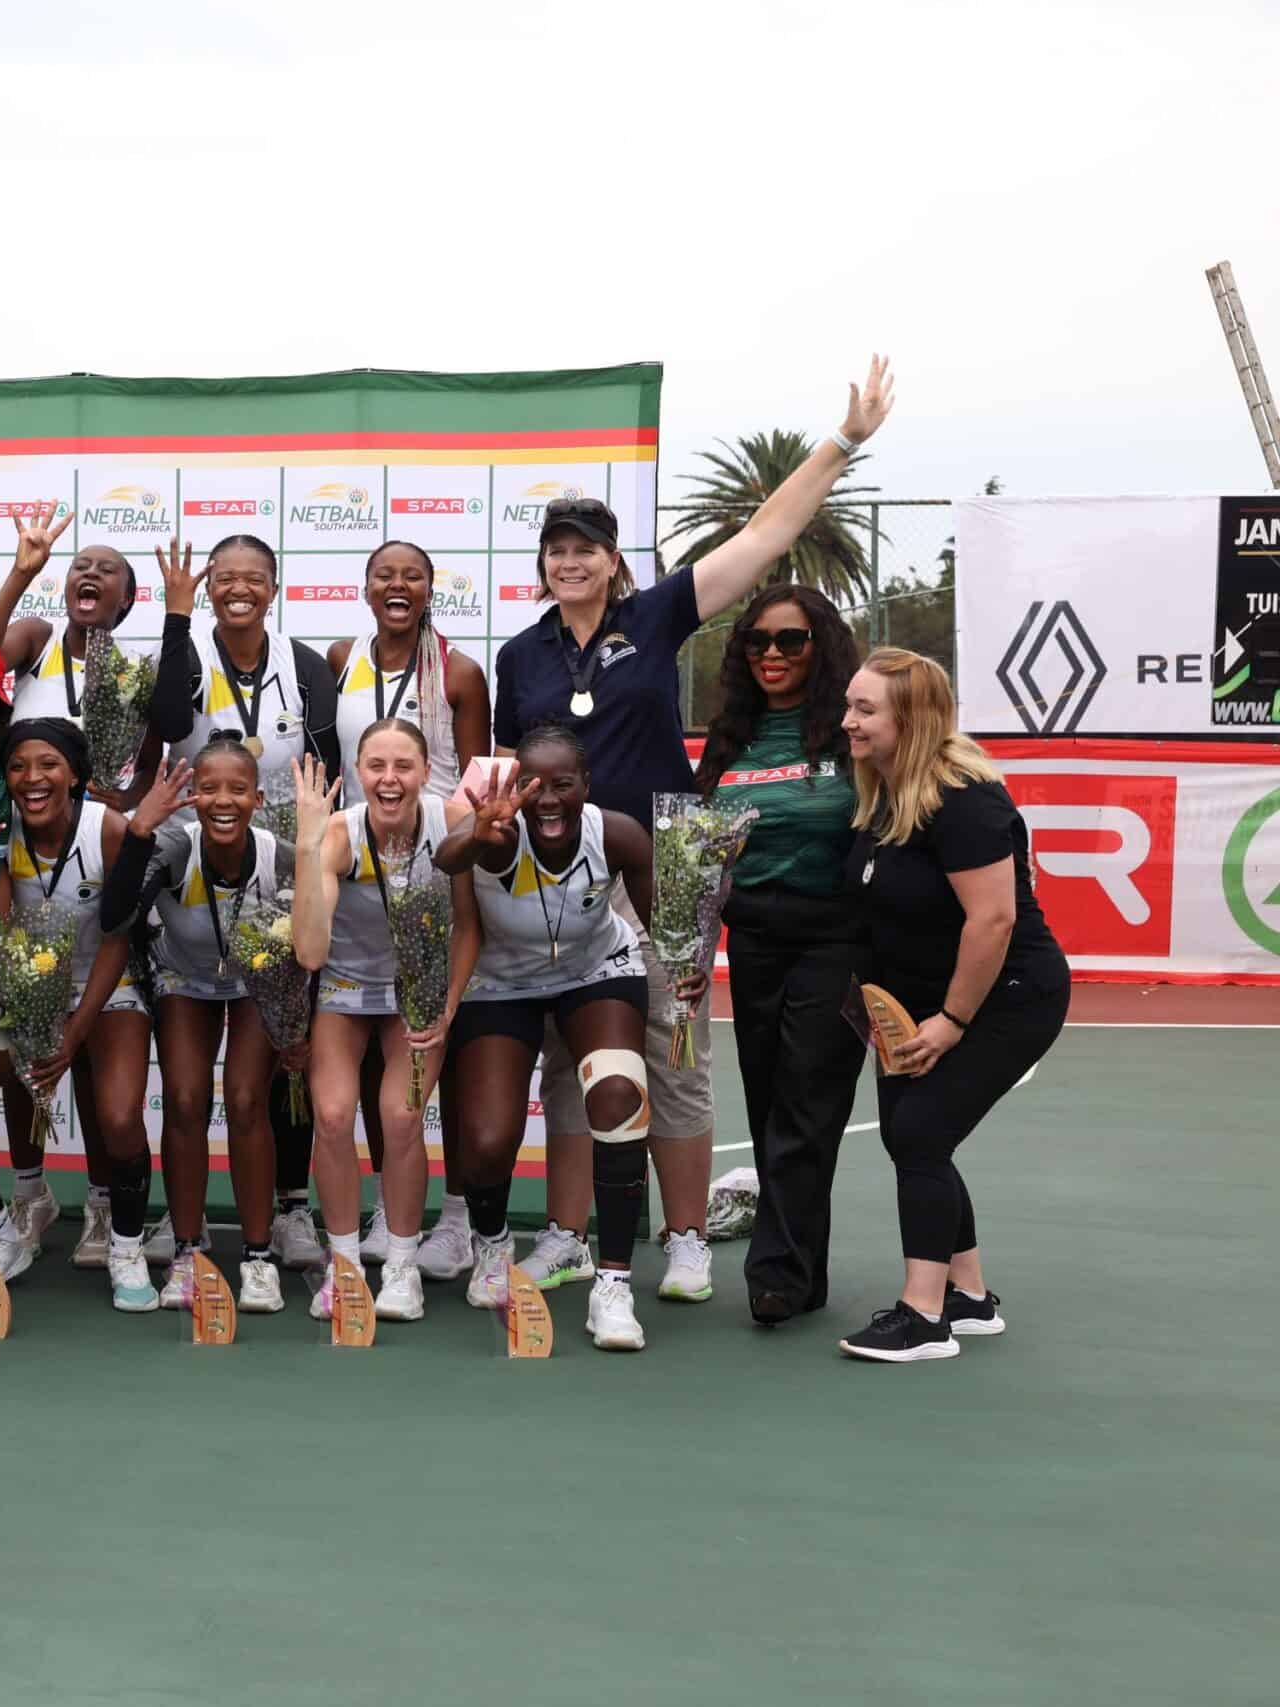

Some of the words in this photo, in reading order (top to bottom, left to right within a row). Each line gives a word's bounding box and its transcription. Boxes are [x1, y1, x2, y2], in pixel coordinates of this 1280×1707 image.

[200, 502, 255, 513] SPAR
[407, 500, 463, 512] SPAR
[84, 508, 171, 524] NETBALL
[290, 506, 378, 522] NETBALL
[108, 525, 136, 533] SOUTH
[138, 525, 171, 533] AFRICA
[314, 522, 344, 531] SOUTH
[346, 522, 378, 531] AFRICA
[303, 587, 357, 598] SPAR
[450, 609, 482, 617] AFRICA
[736, 766, 804, 782] SPAR
